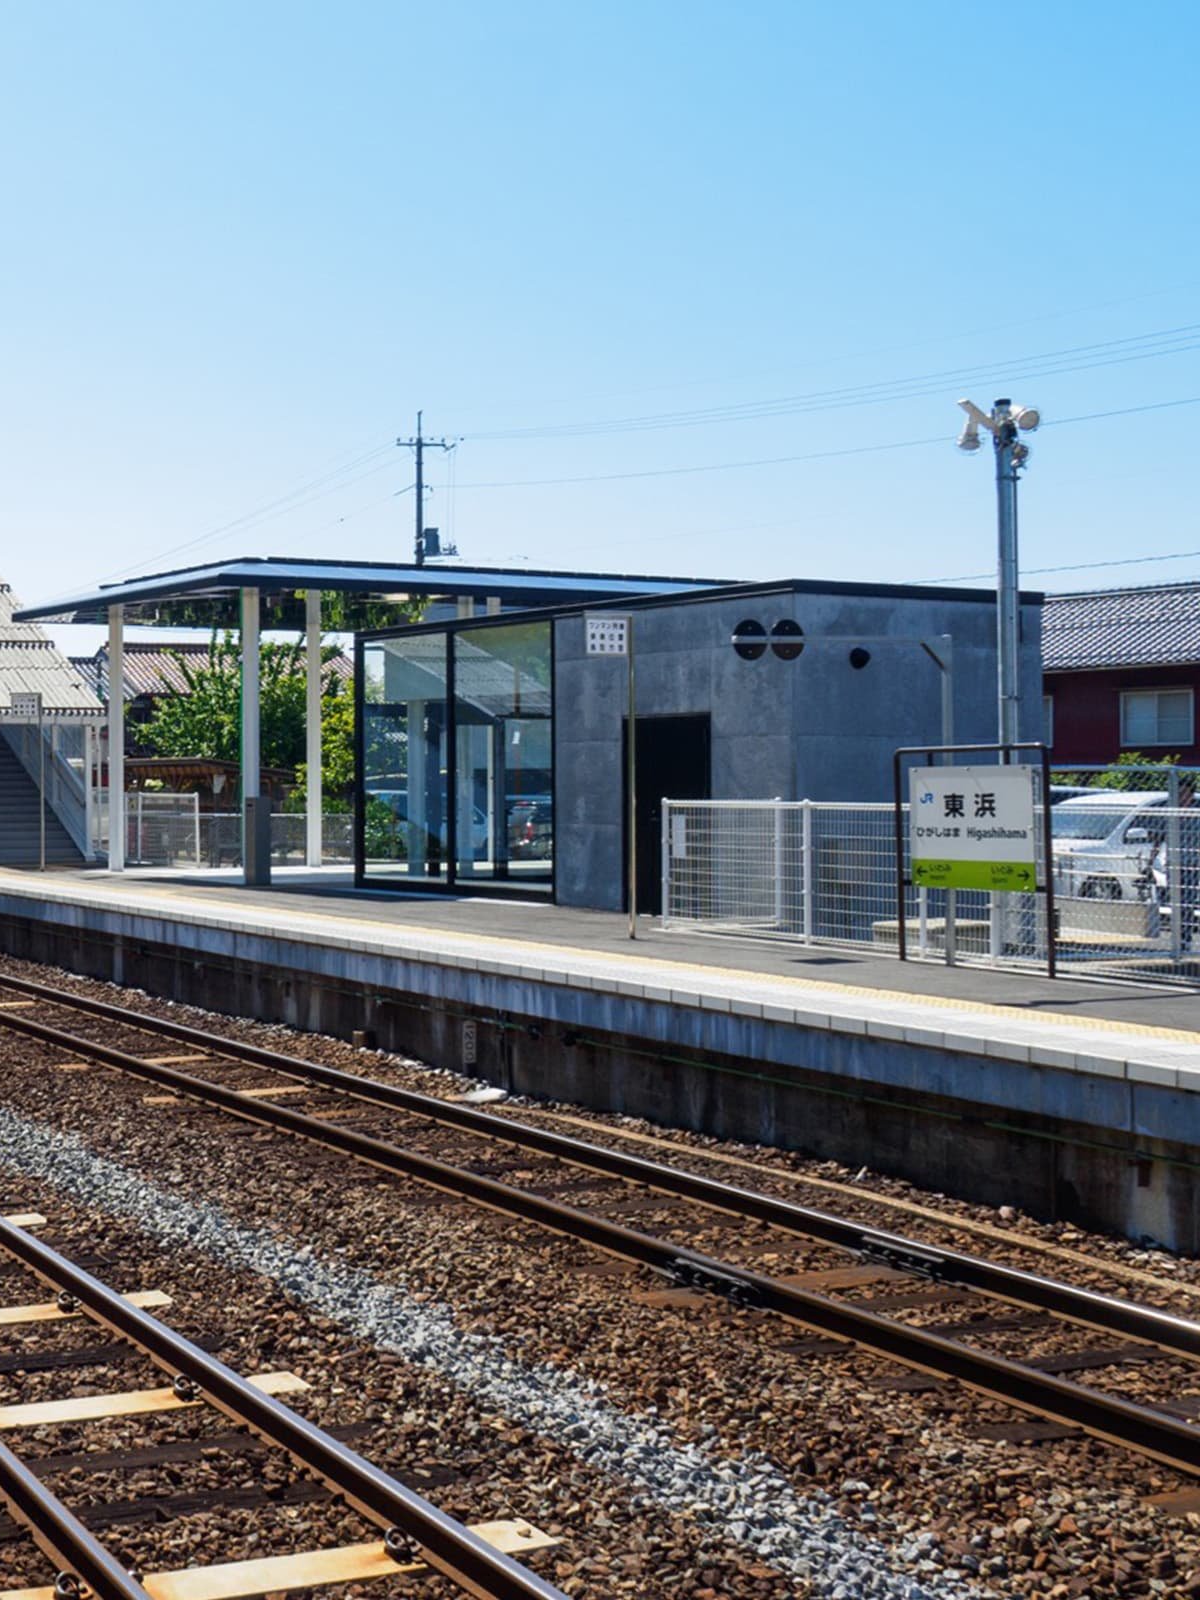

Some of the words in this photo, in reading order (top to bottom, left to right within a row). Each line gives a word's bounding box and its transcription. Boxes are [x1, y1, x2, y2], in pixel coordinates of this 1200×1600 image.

[920, 793, 934, 804] JR
[943, 793, 996, 818] 東浜
[916, 827, 961, 838] ひがしはま
[966, 827, 1028, 841] Higashihama
